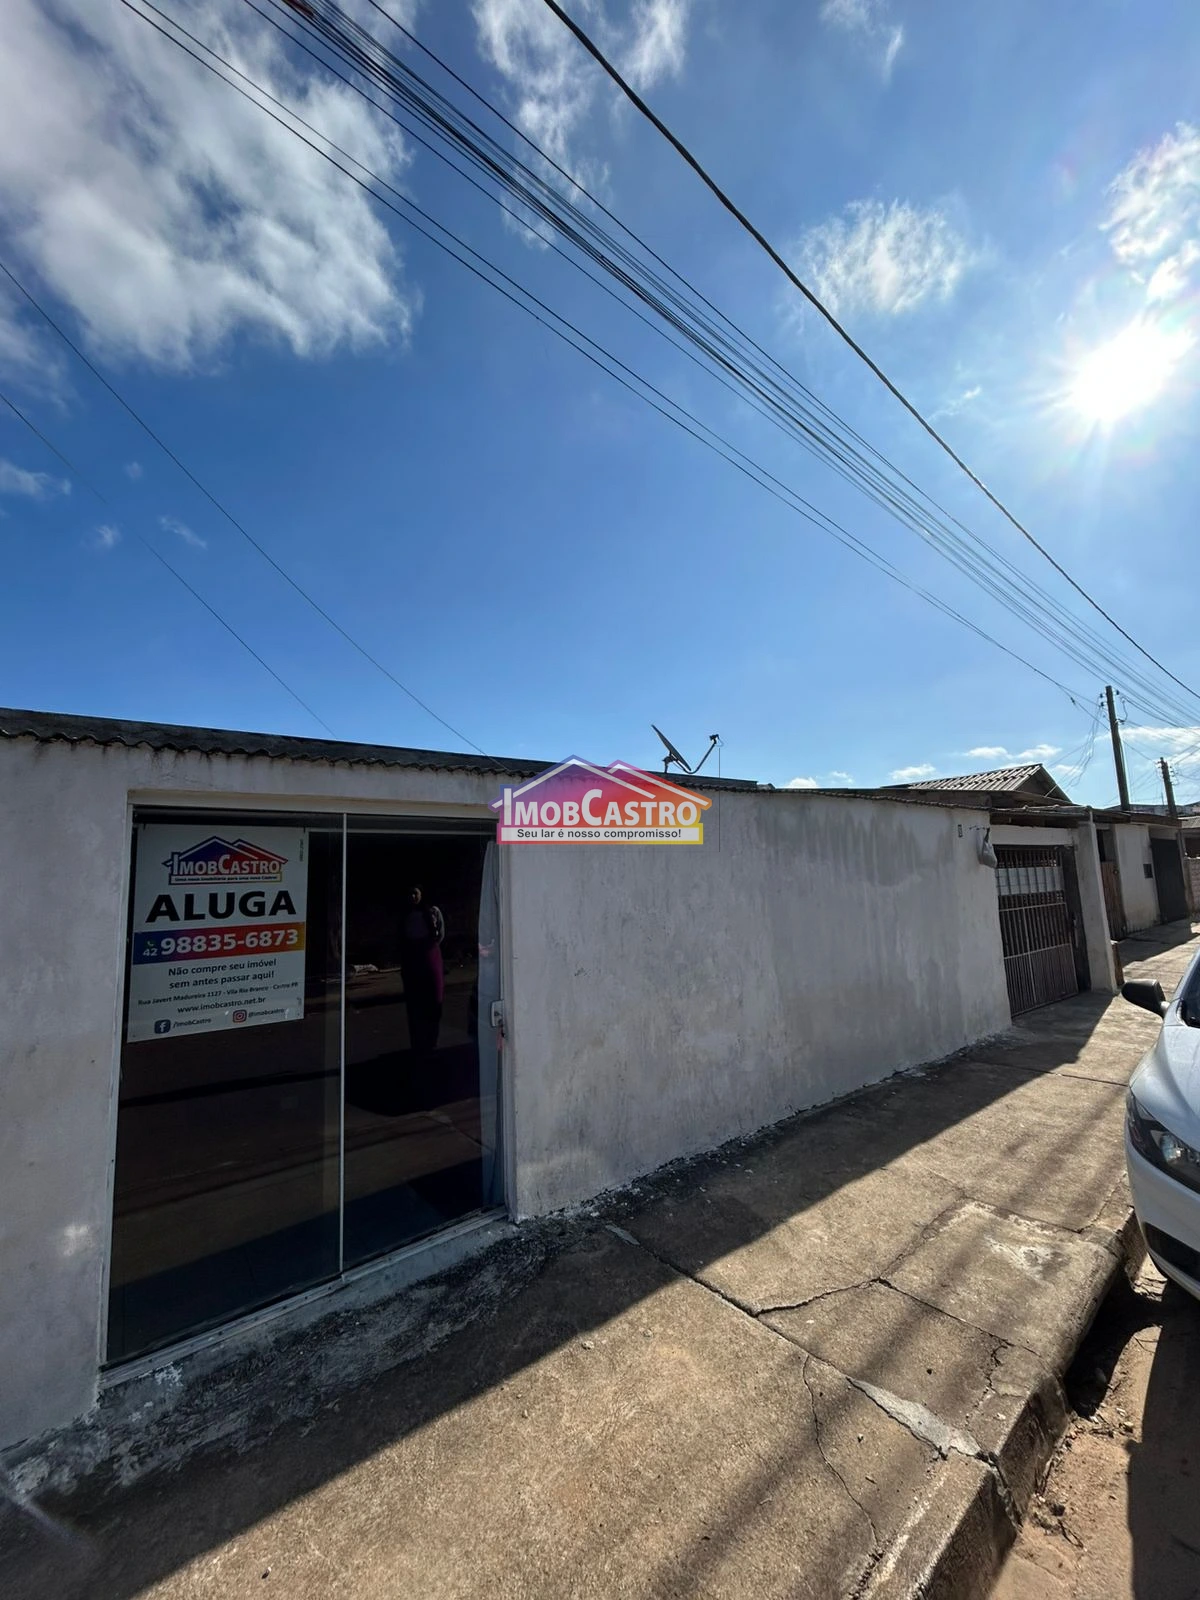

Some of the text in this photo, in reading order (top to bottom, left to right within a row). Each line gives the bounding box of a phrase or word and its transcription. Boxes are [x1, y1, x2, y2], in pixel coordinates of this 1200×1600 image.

[145, 890, 297, 923] ALUGA
[143, 929, 299, 957] 42 98835-6873
[168, 958, 277, 976] Não compre seu imóvel
[169, 971, 275, 989] sem antes passar aqui!
[173, 993, 206, 1001] Madureira
[177, 996, 266, 1014] www.imobcastro.net.br
